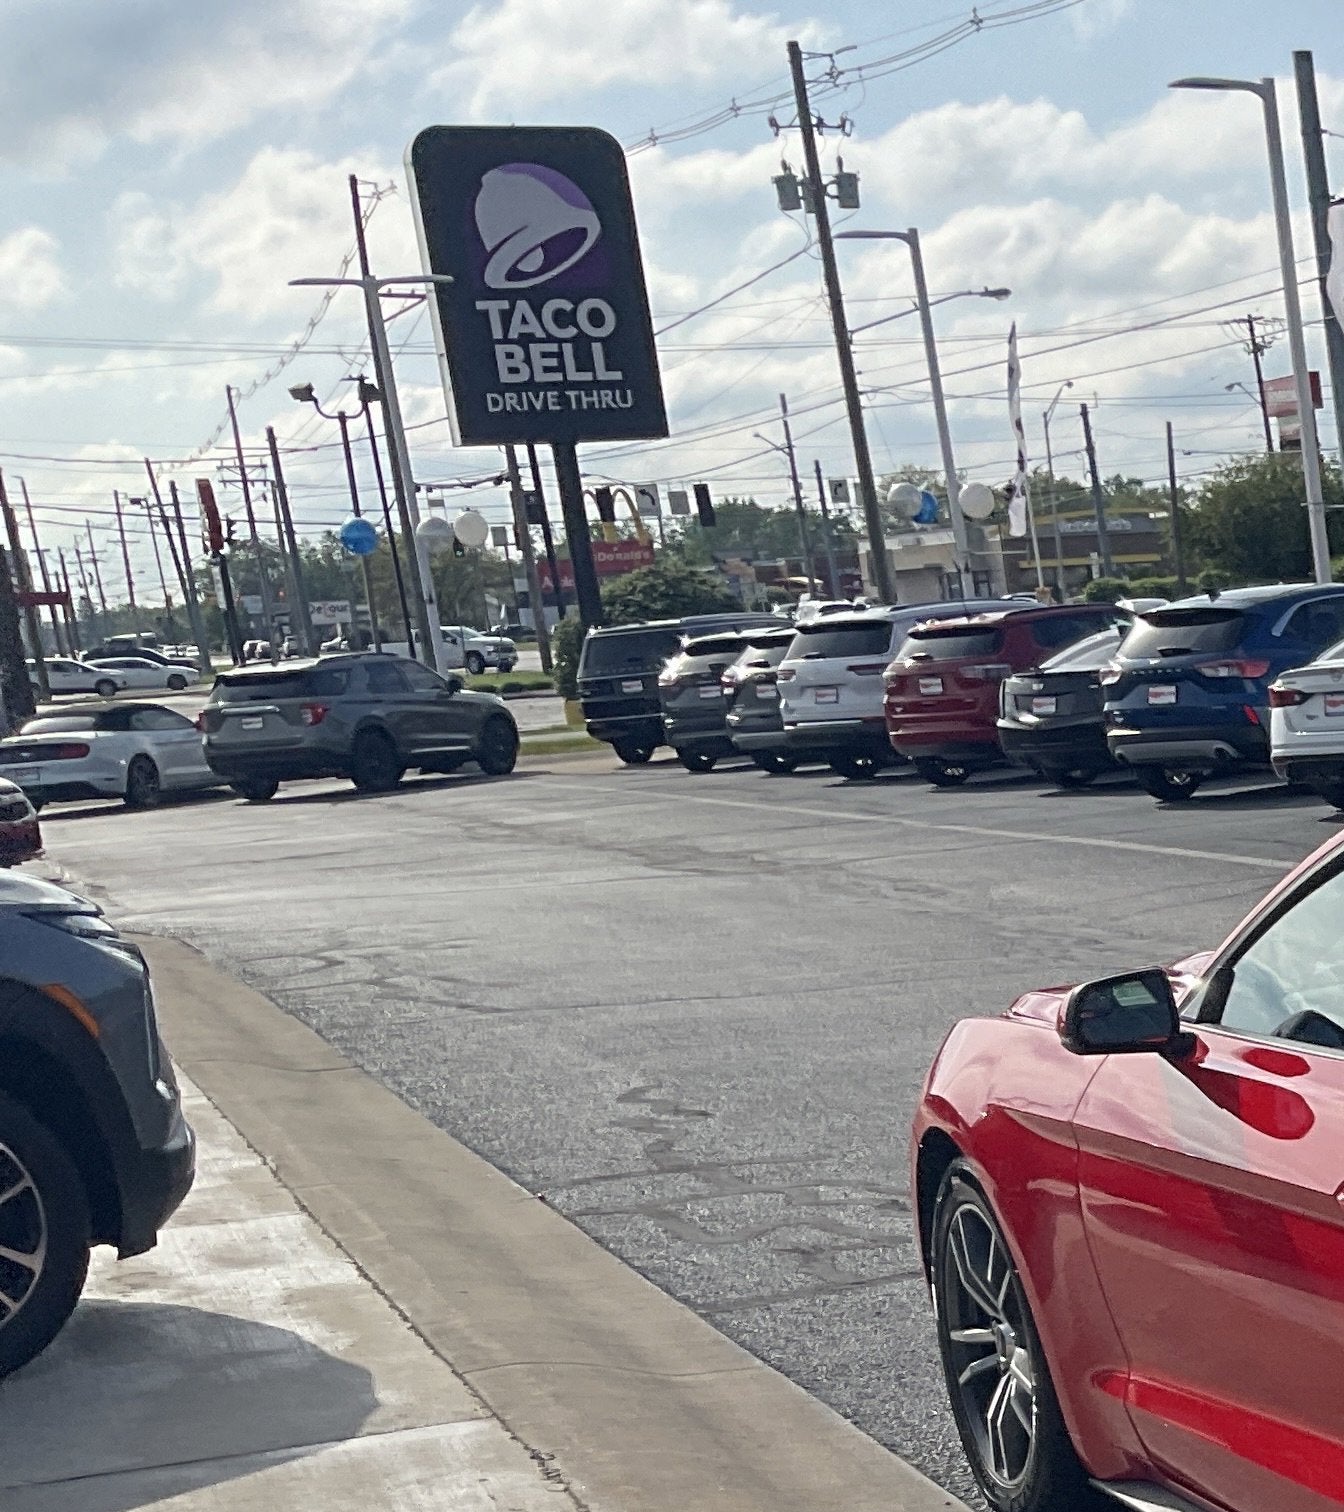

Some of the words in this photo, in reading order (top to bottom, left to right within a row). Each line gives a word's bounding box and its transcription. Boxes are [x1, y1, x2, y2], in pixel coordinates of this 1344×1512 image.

[475, 298, 616, 339] TACO
[494, 342, 623, 383] BELL
[486, 391, 561, 413] DRIVE
[564, 389, 633, 410] THRU
